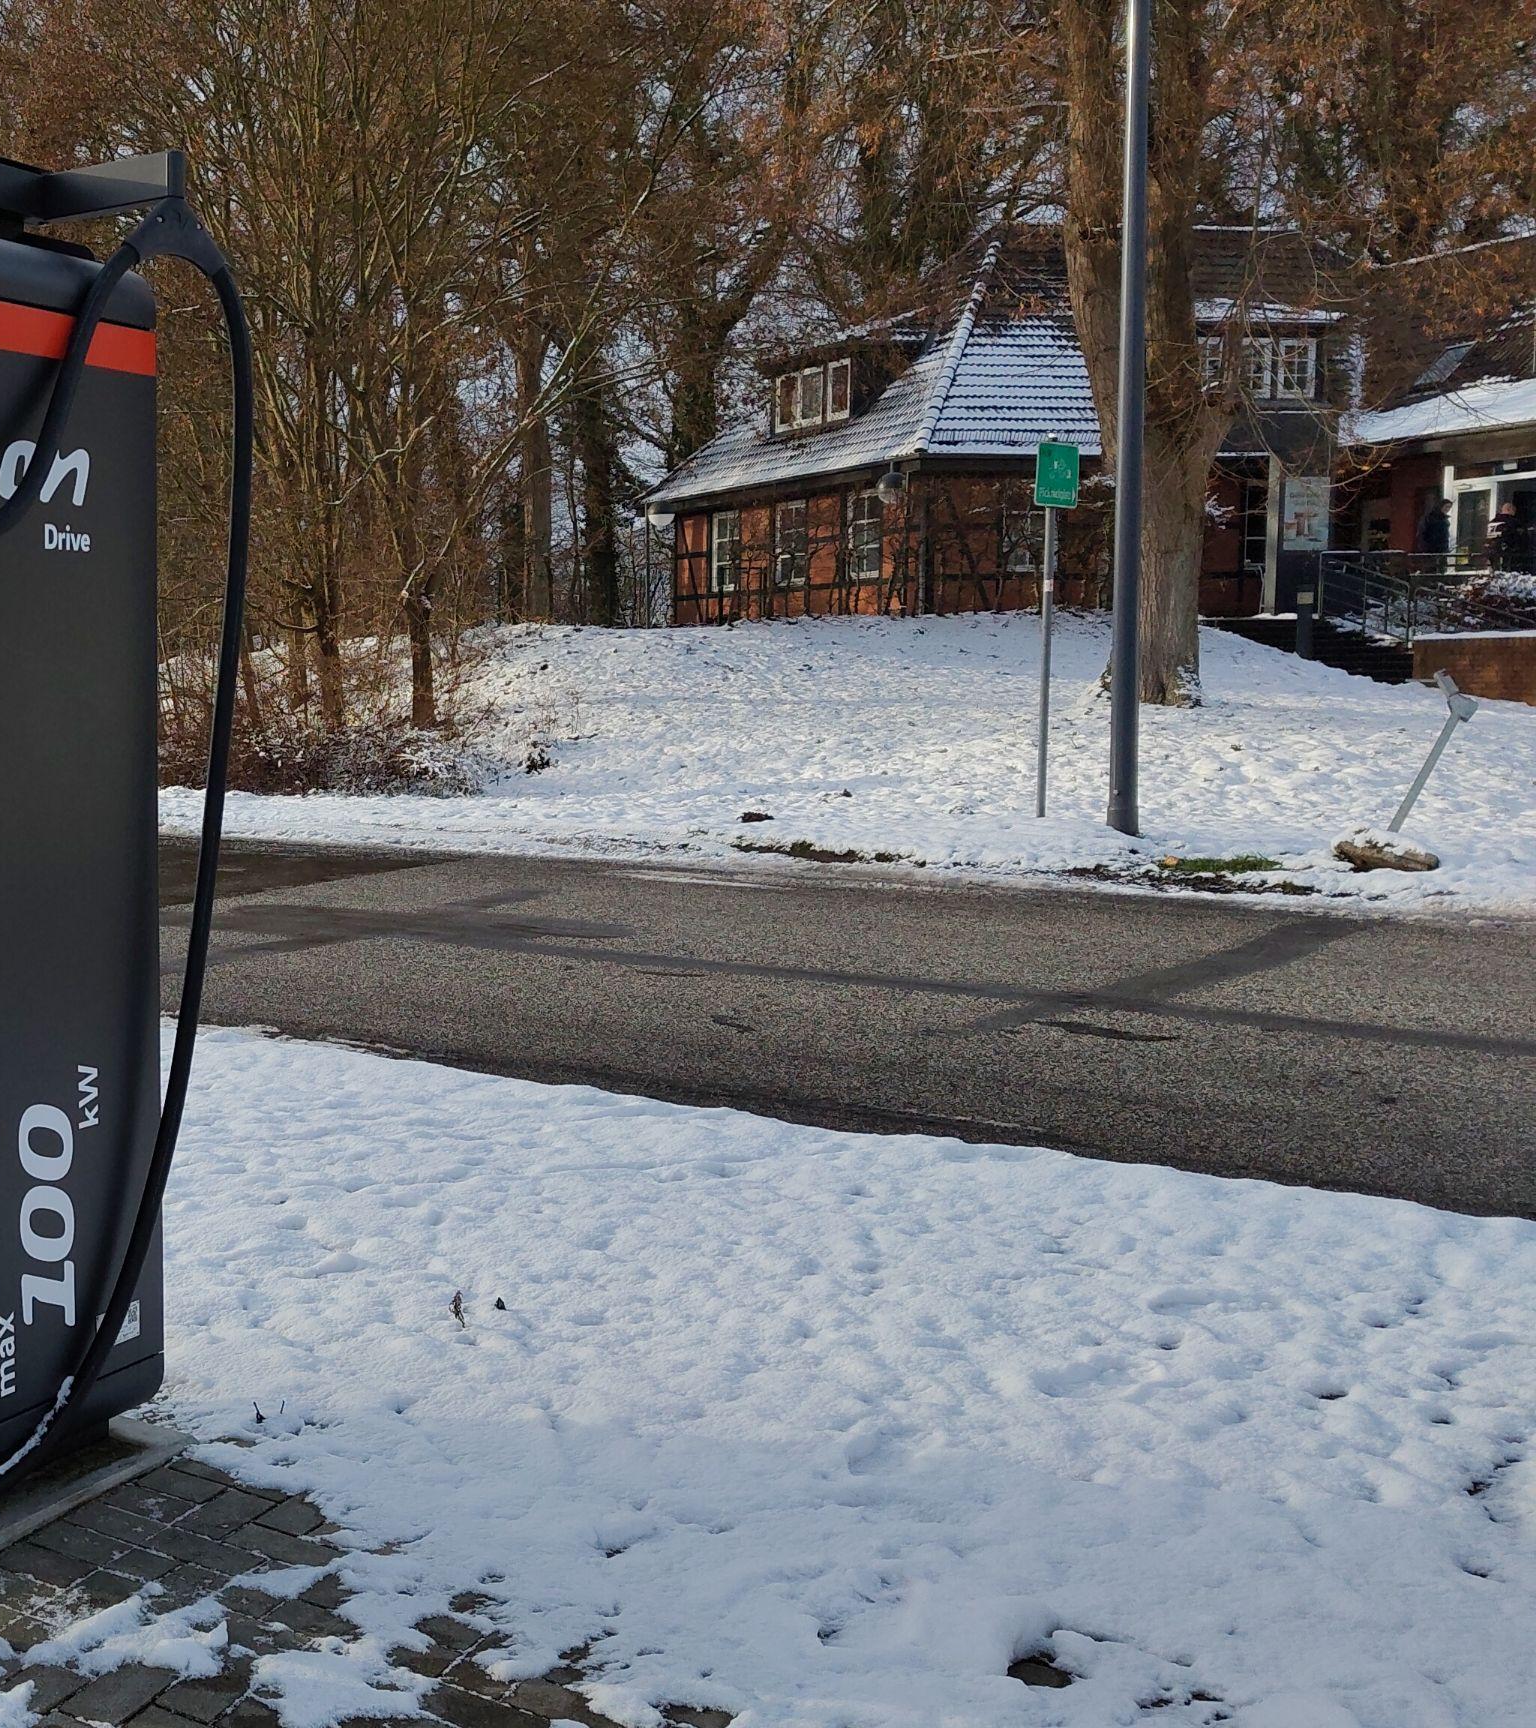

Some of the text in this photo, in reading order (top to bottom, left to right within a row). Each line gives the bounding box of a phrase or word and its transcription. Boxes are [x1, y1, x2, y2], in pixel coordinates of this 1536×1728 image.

[44, 523, 91, 553] Drive
[18, 1103, 76, 1327] 100
[77, 1065, 100, 1130] kW
